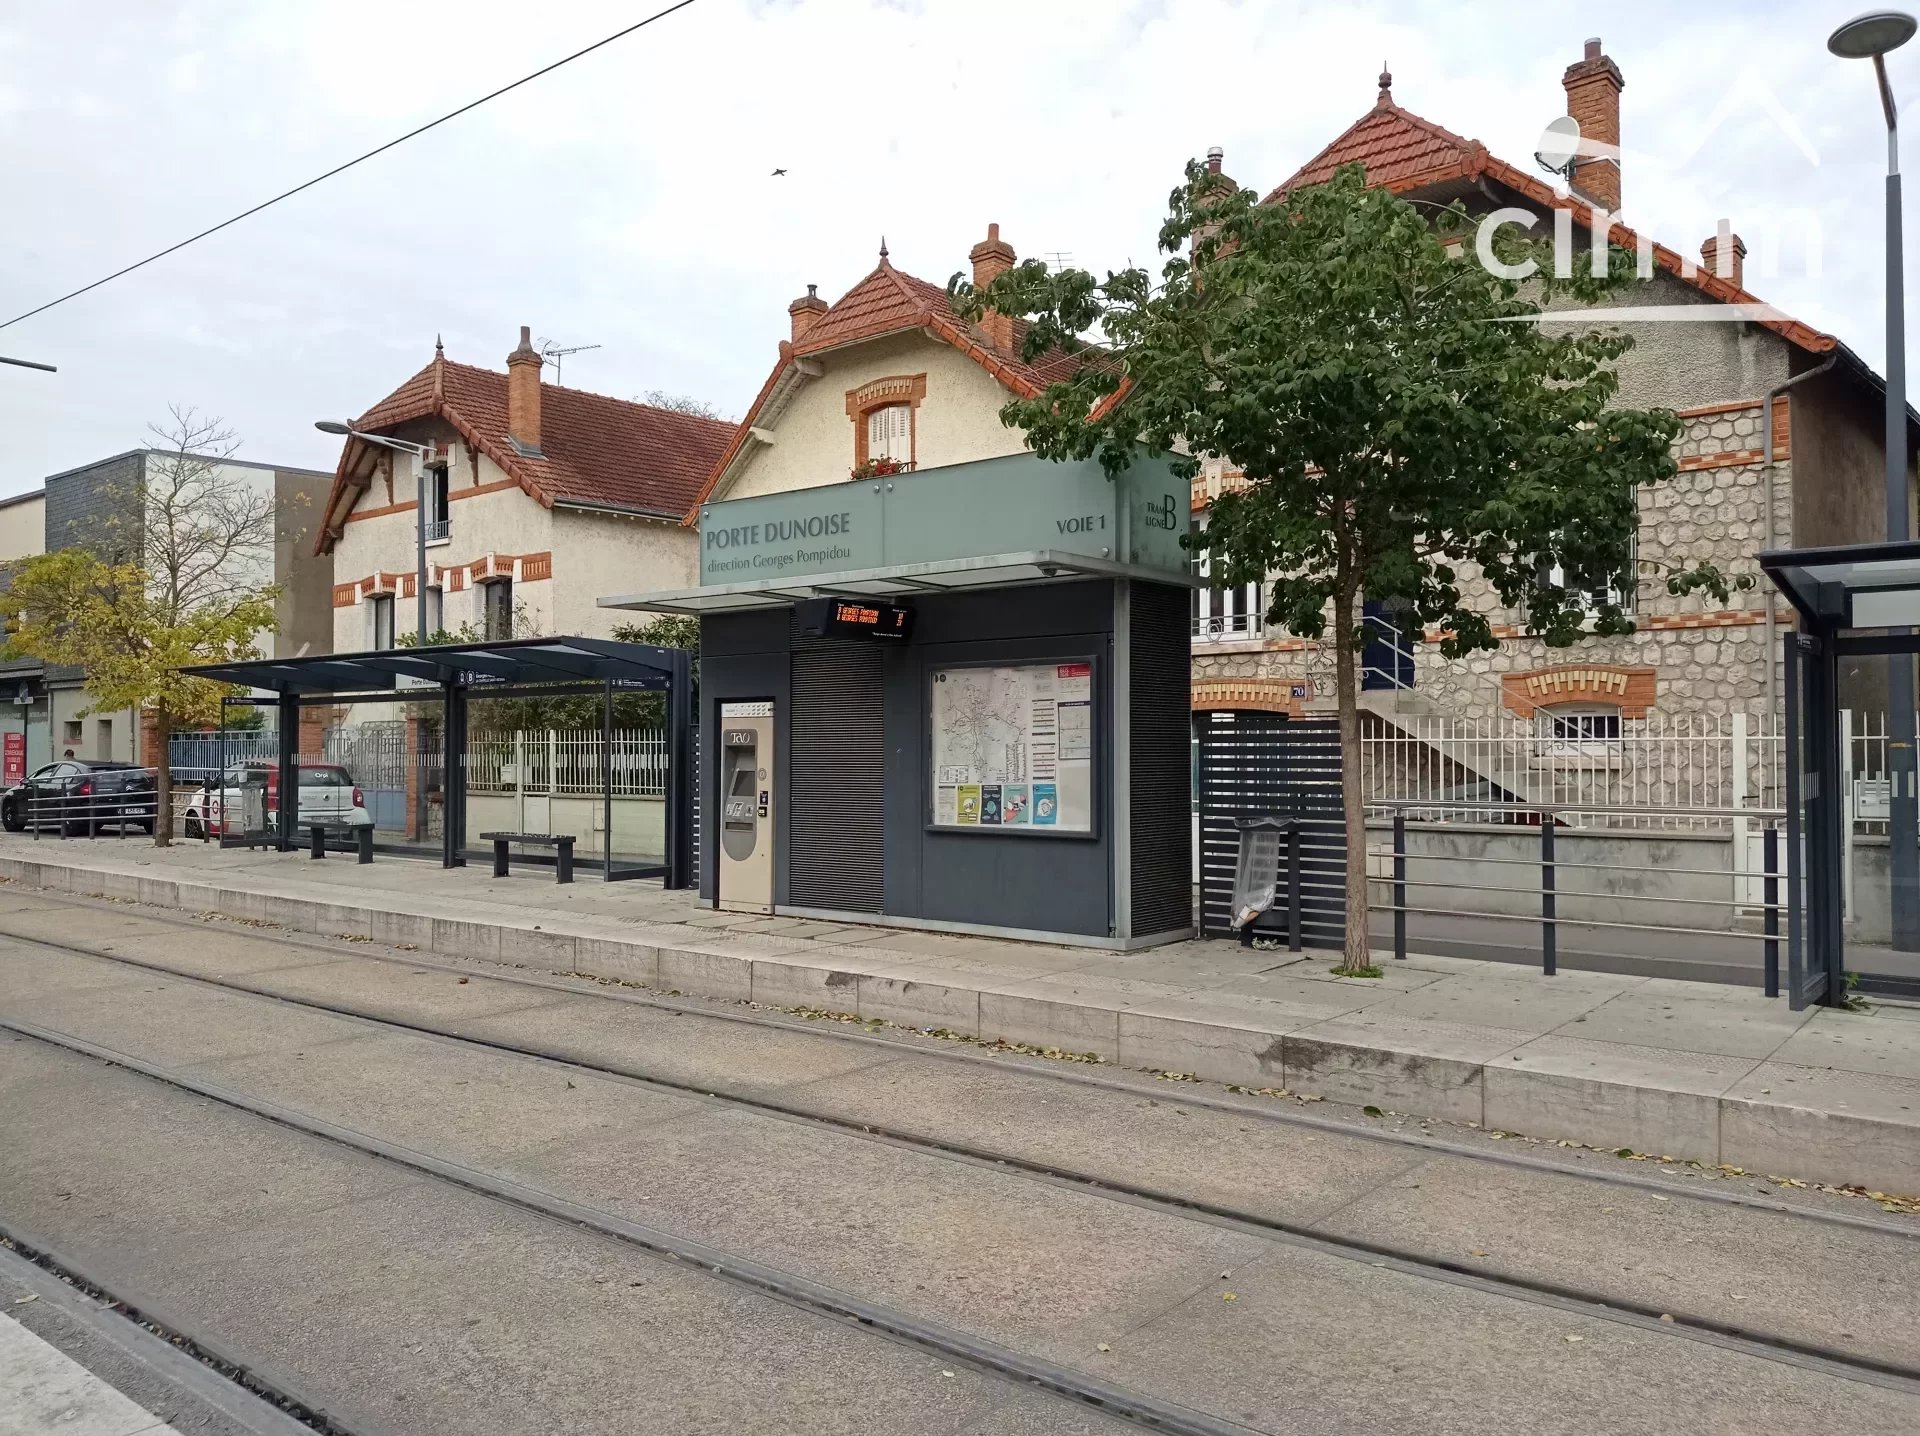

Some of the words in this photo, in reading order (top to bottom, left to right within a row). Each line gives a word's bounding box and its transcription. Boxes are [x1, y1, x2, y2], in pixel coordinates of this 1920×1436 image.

[1147, 502, 1165, 516] TRAM
[1164, 494, 1177, 530] B
[706, 525, 759, 550] PORTE
[765, 512, 850, 543] DUNOISE
[1056, 516, 1094, 535] VOIE
[1098, 514, 1105, 529] 1
[1145, 516, 1165, 529] LIGNE
[708, 559, 750, 573] direction
[752, 554, 794, 569] Georges
[797, 545, 850, 565] Pompidou
[1293, 687, 1304, 696] 70
